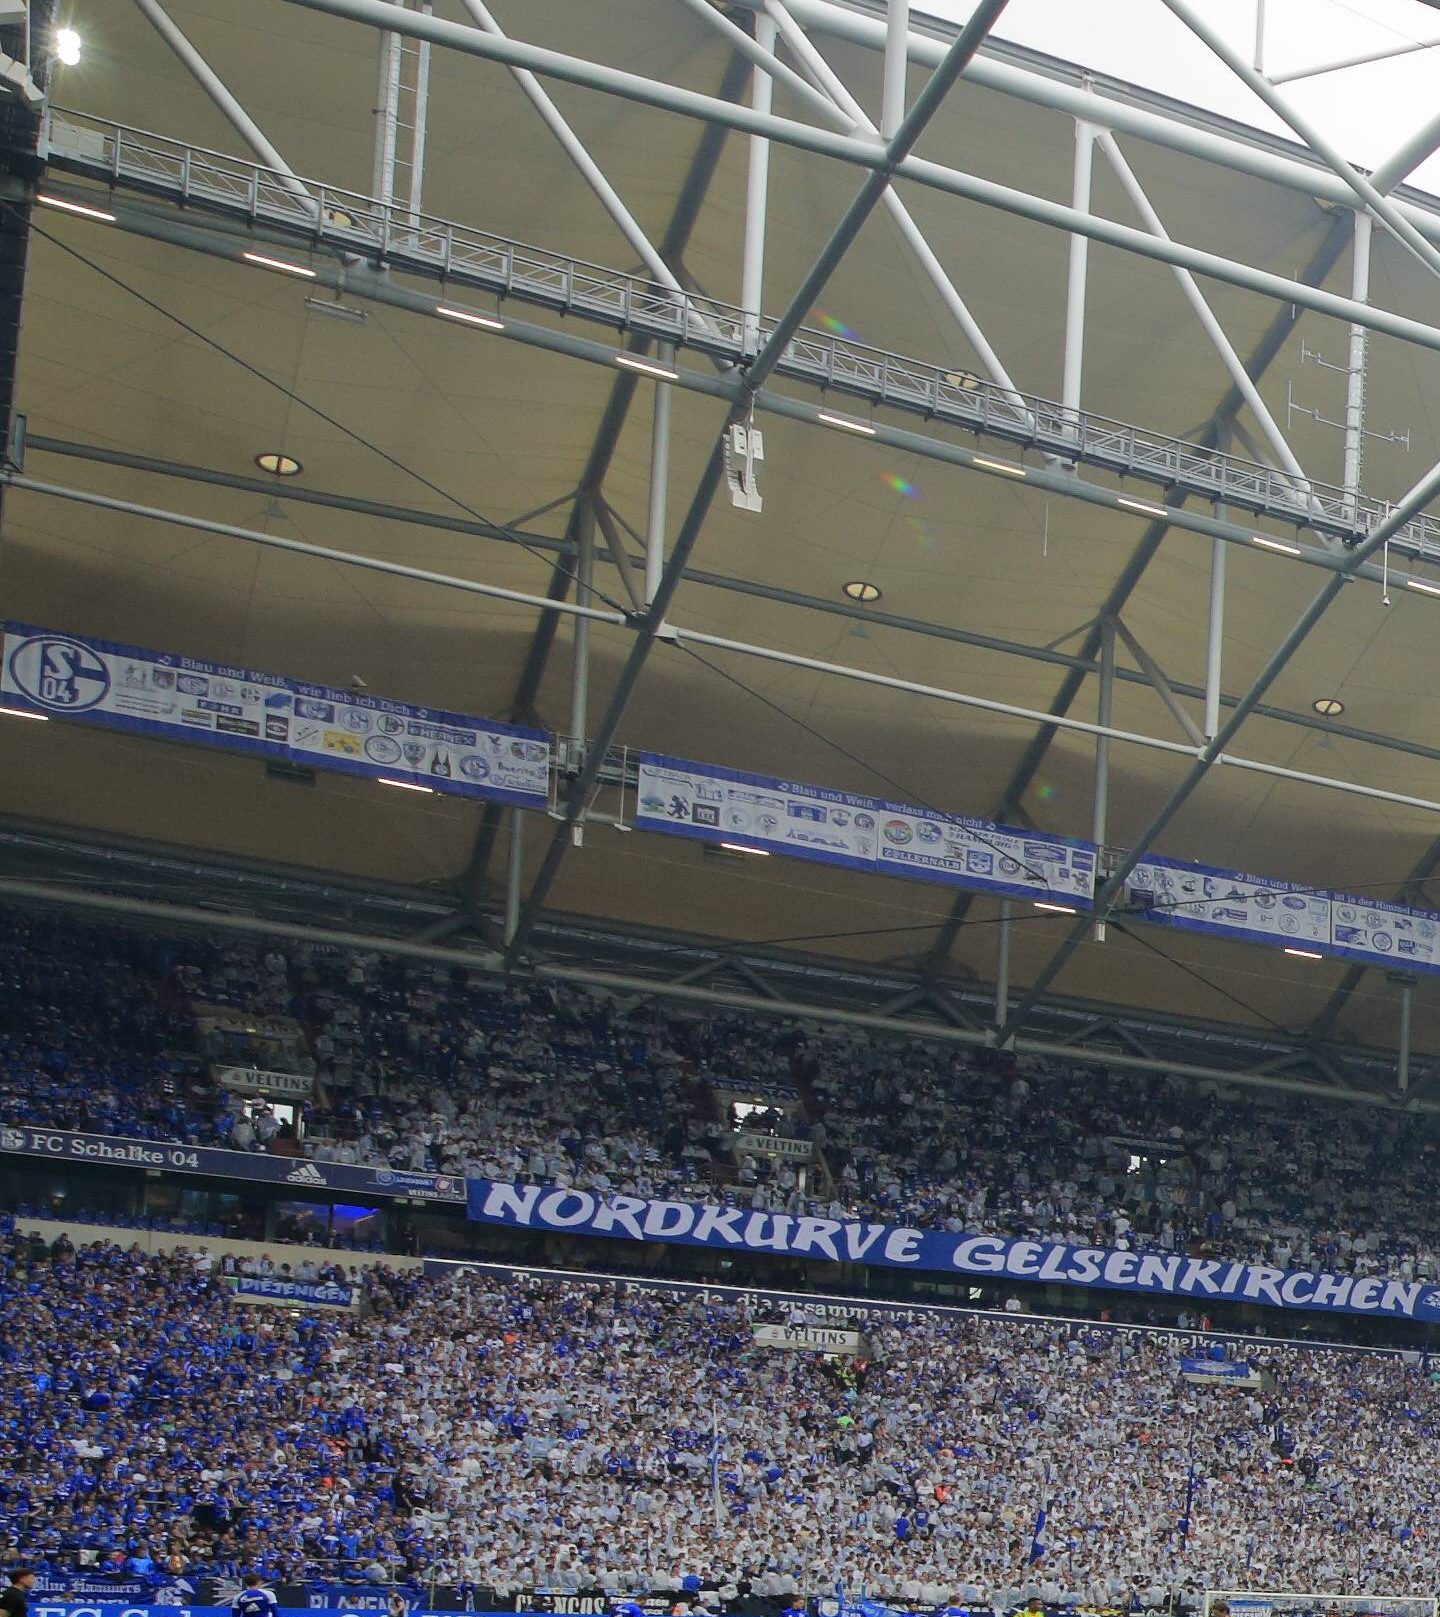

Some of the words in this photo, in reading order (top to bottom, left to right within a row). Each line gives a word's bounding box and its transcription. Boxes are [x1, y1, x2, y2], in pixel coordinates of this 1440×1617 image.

[181, 657, 212, 673] Blau
[218, 666, 245, 680] und
[296, 684, 322, 698] wie
[379, 700, 411, 716] Dich
[791, 783, 817, 797] Blau
[820, 789, 842, 802] und
[244, 1071, 310, 1092] VELTINS
[30, 1134, 64, 1152] FC
[71, 1139, 164, 1165] Schalke
[757, 1138, 810, 1154] VELTINS
[484, 1182, 924, 1262] NORDKURVE
[952, 1235, 1421, 1317] GELSENKIRCHEN
[240, 1278, 351, 1303] DIEJENIGEN
[784, 1328, 847, 1345] VELTINS
